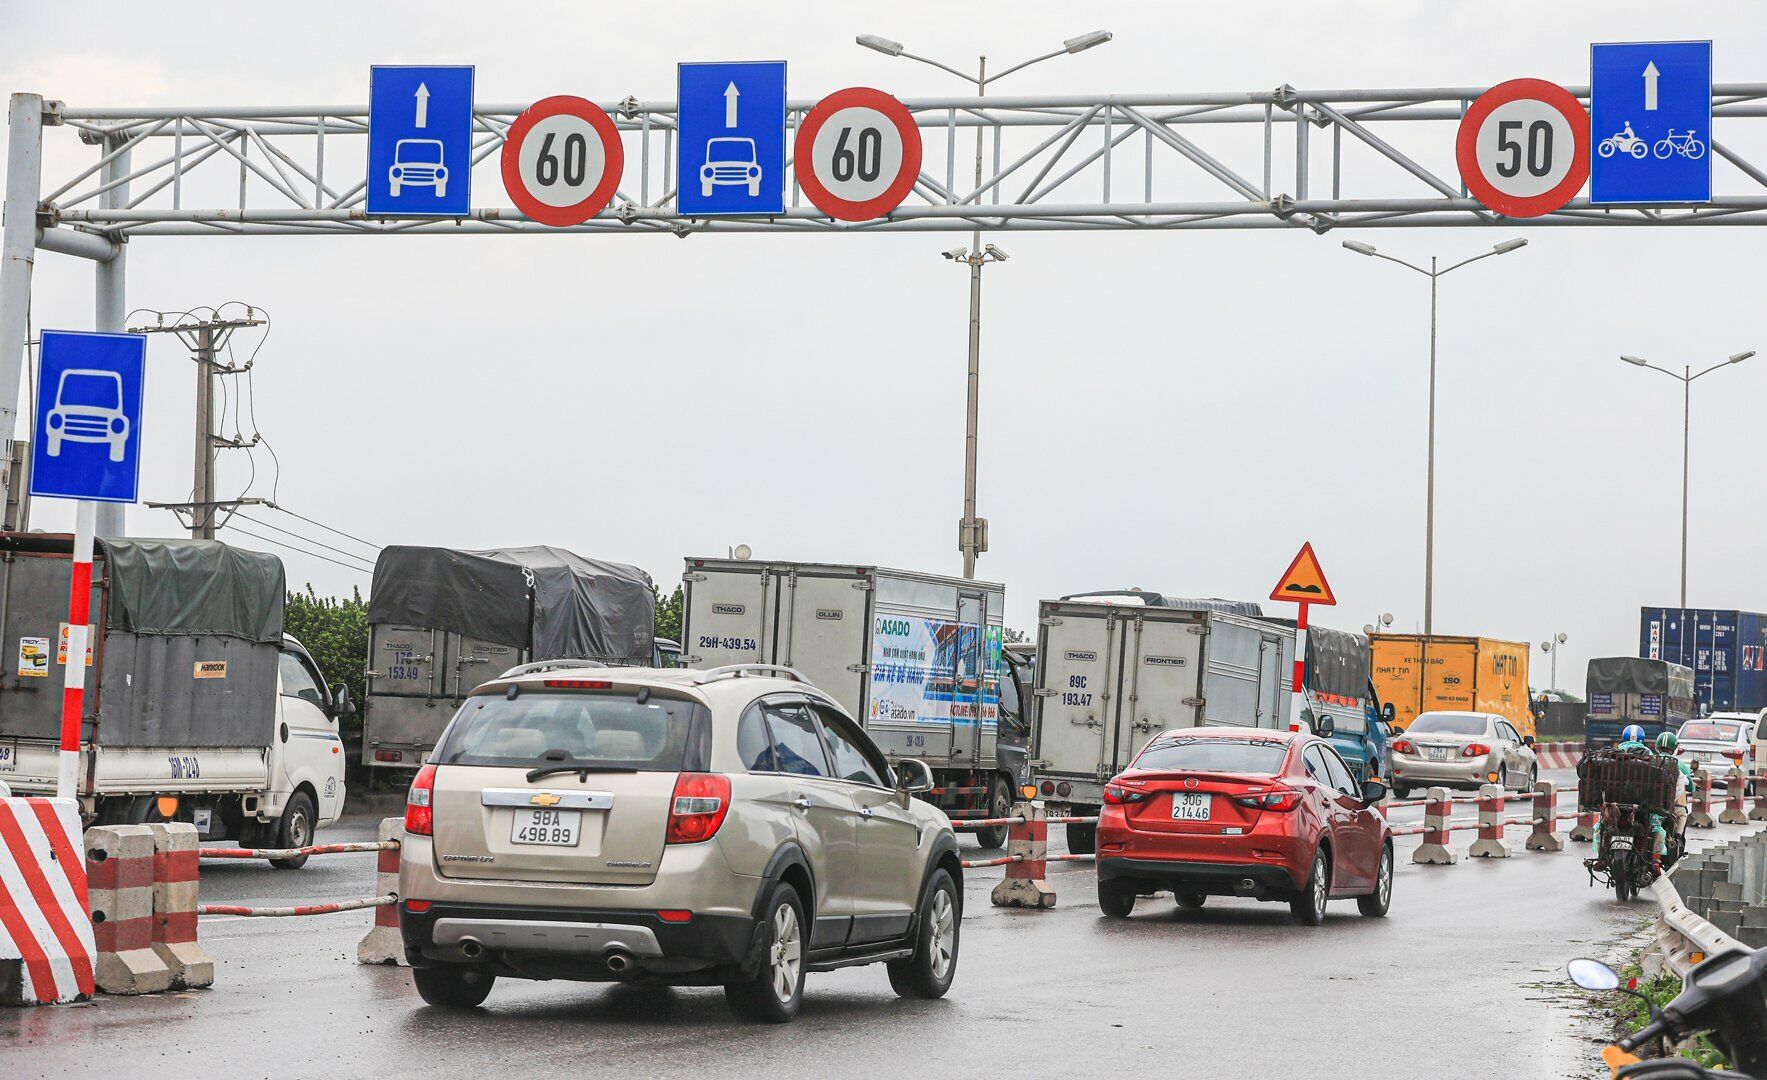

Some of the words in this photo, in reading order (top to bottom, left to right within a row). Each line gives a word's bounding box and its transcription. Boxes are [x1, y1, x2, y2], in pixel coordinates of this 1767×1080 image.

[831, 127, 882, 182] 60
[1496, 120, 1553, 178] 50
[536, 133, 587, 187] 60
[881, 619, 910, 636] ASADO
[699, 636, 756, 650] 29H-439.54
[1068, 652, 1094, 660] THACO
[1146, 657, 1185, 665] FRONTIER
[388, 666, 418, 680] 153.49
[1069, 675, 1087, 689] 89C
[1062, 692, 1092, 706] 193.47
[1182, 794, 1202, 806] 30G
[532, 810, 560, 826] 98A
[1173, 806, 1209, 819] 214.46
[518, 827, 571, 843] 498.89
